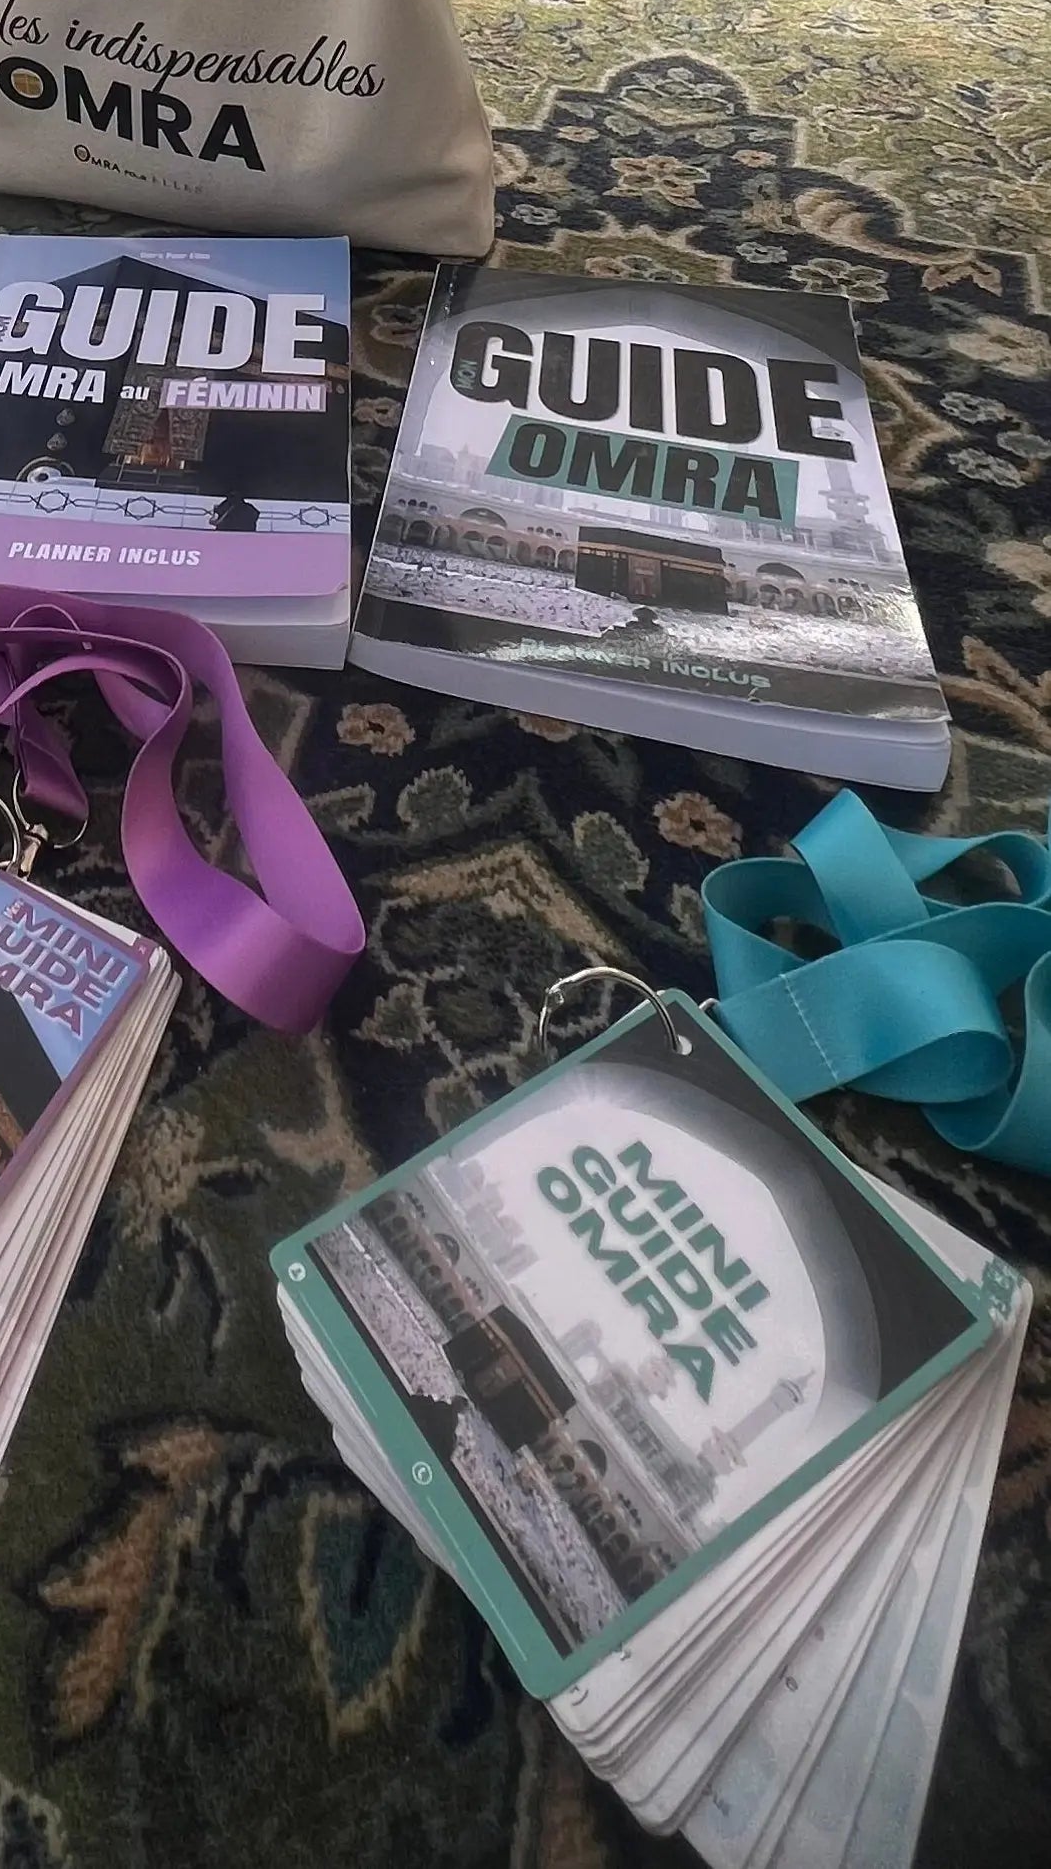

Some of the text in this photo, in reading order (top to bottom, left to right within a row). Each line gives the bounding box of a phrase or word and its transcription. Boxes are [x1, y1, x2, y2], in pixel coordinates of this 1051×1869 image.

[65, 22, 385, 98] indispensables
[120, 382, 150, 400] au
[165, 377, 322, 411] FÉMININ
[450, 320, 856, 462] GUIDE
[508, 422, 783, 520] OMRA
[8, 541, 201, 566] PLANNER INCLUS
[10, 902, 129, 984] MINI
[571, 1145, 758, 1368] GUIDE
[617, 1140, 771, 1312] MINI
[536, 1166, 716, 1406] OMRA
